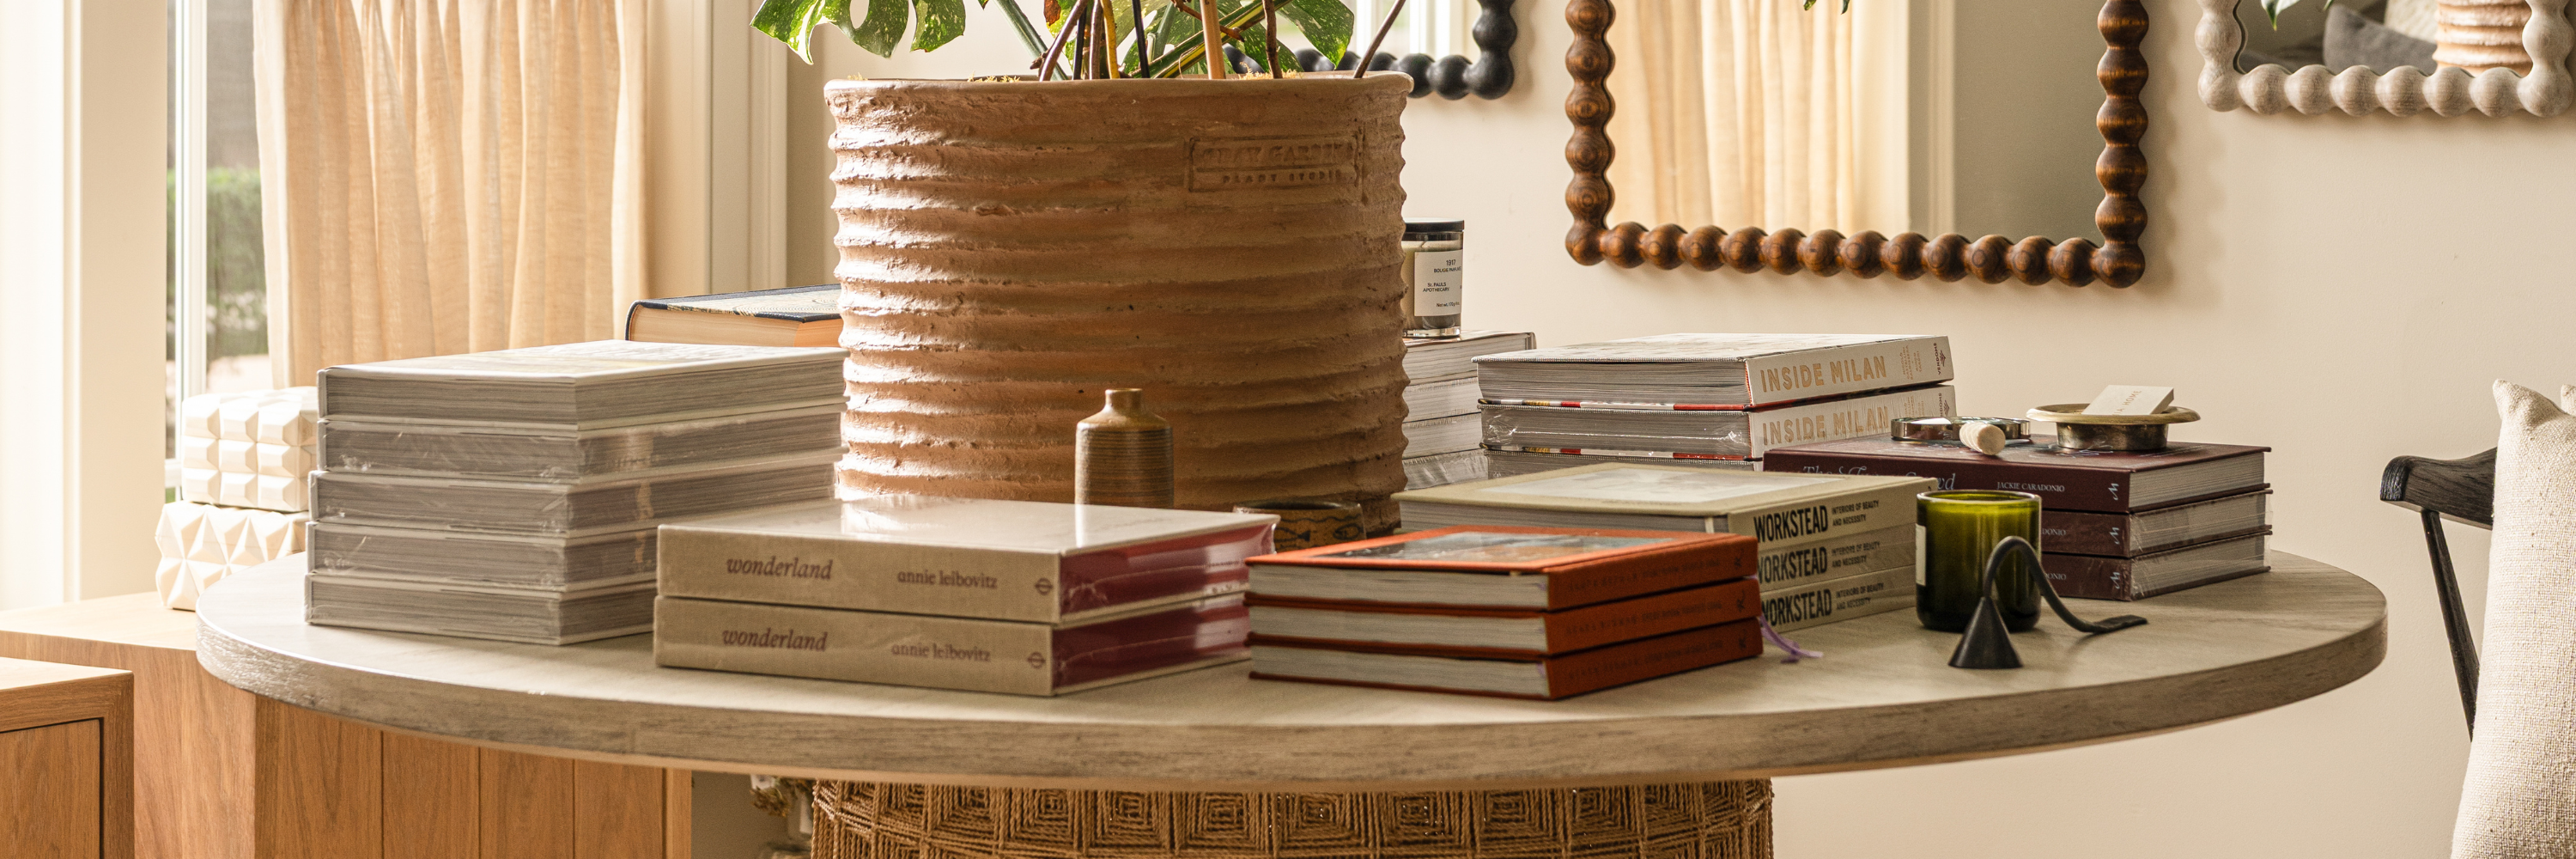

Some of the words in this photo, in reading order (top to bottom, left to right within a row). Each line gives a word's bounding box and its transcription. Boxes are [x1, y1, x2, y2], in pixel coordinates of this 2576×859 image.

[1760, 362, 1825, 393] INSIDE
[1829, 355, 1887, 385] MILAN
[1933, 342, 1941, 375] VENDOME
[2123, 390, 2142, 405] HOME
[1762, 414, 1826, 446] INSIDE
[1832, 405, 1889, 436] MILAN
[1996, 481, 2020, 490] JACKIE
[2021, 483, 2065, 492] CARADONIO
[1753, 505, 1829, 543] WORKSTEAD
[1832, 503, 1855, 515] INTERIORS
[1856, 502, 1862, 511] OF
[1862, 500, 1880, 510] BEAUTY
[1832, 518, 1842, 527] AND
[1843, 514, 1867, 525] NECESSITY
[1831, 544, 1855, 557] INTERIORS
[1856, 543, 1862, 552] OF
[1862, 540, 1880, 551] BEAUTY
[1832, 559, 1842, 568] AND
[1843, 555, 1867, 566] NECESSITY
[726, 556, 834, 581] wonderland
[897, 569, 936, 586] annie
[939, 569, 998, 590] leibovitz
[1761, 588, 1832, 627] WORKSTEAD
[1836, 586, 1859, 598] INTERIORS
[1860, 585, 1867, 594] OF
[1867, 582, 1885, 593] BEAUTY
[1836, 601, 1845, 611] AND
[1846, 597, 1871, 608] NECESSITY
[721, 628, 829, 652] wonderland
[891, 643, 930, 659] annie
[933, 643, 991, 662] leibovitz
